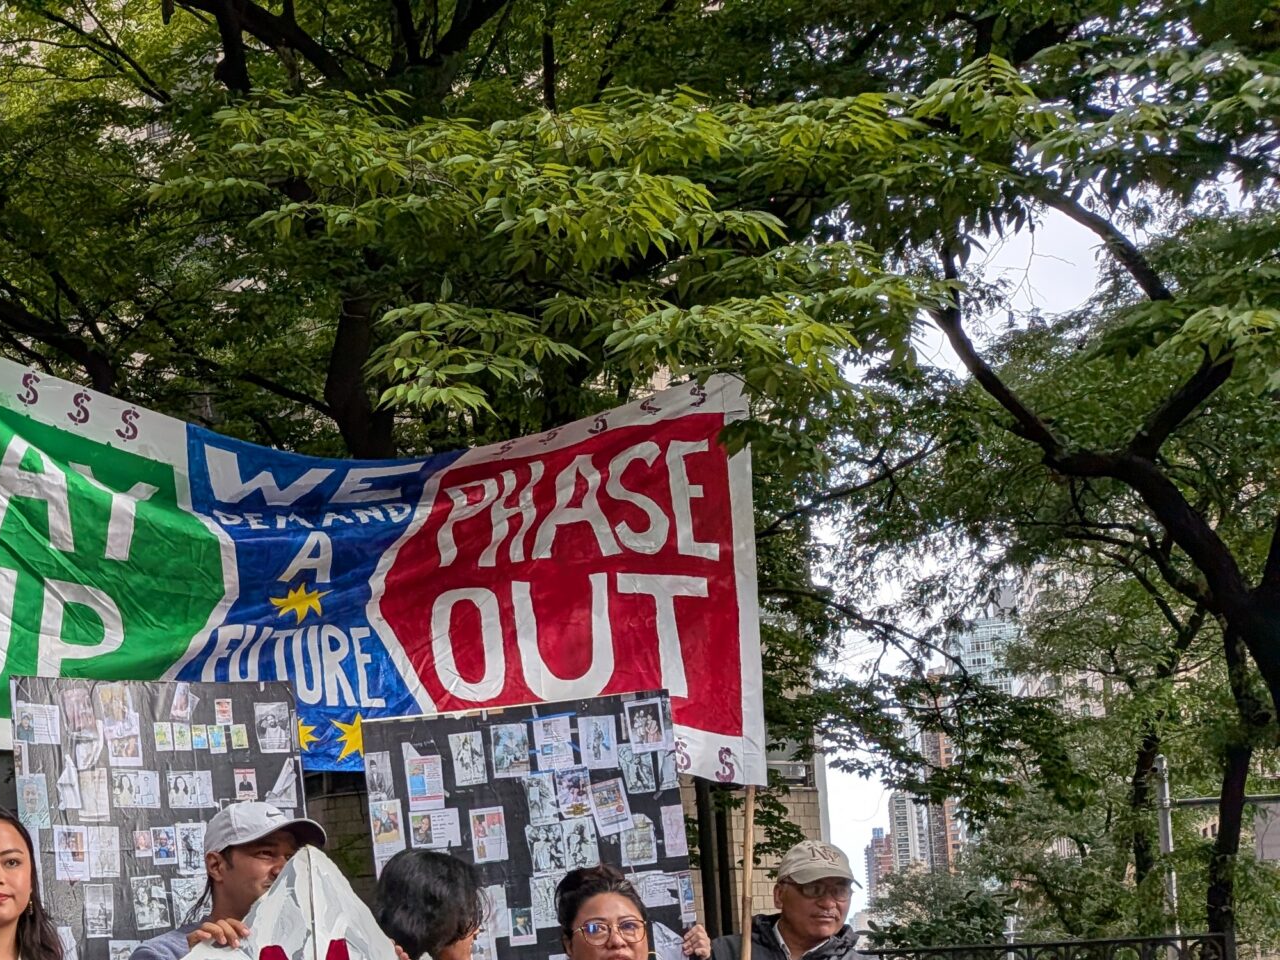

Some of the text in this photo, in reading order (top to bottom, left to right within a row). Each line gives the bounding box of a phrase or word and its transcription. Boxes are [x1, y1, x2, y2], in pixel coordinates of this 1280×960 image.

[204, 443, 424, 507] WE
[437, 440, 721, 568] PHASE
[212, 503, 412, 530] DEMAND
[277, 531, 333, 583] A
[201, 624, 386, 708] FUTURE
[431, 573, 709, 701] OUT
